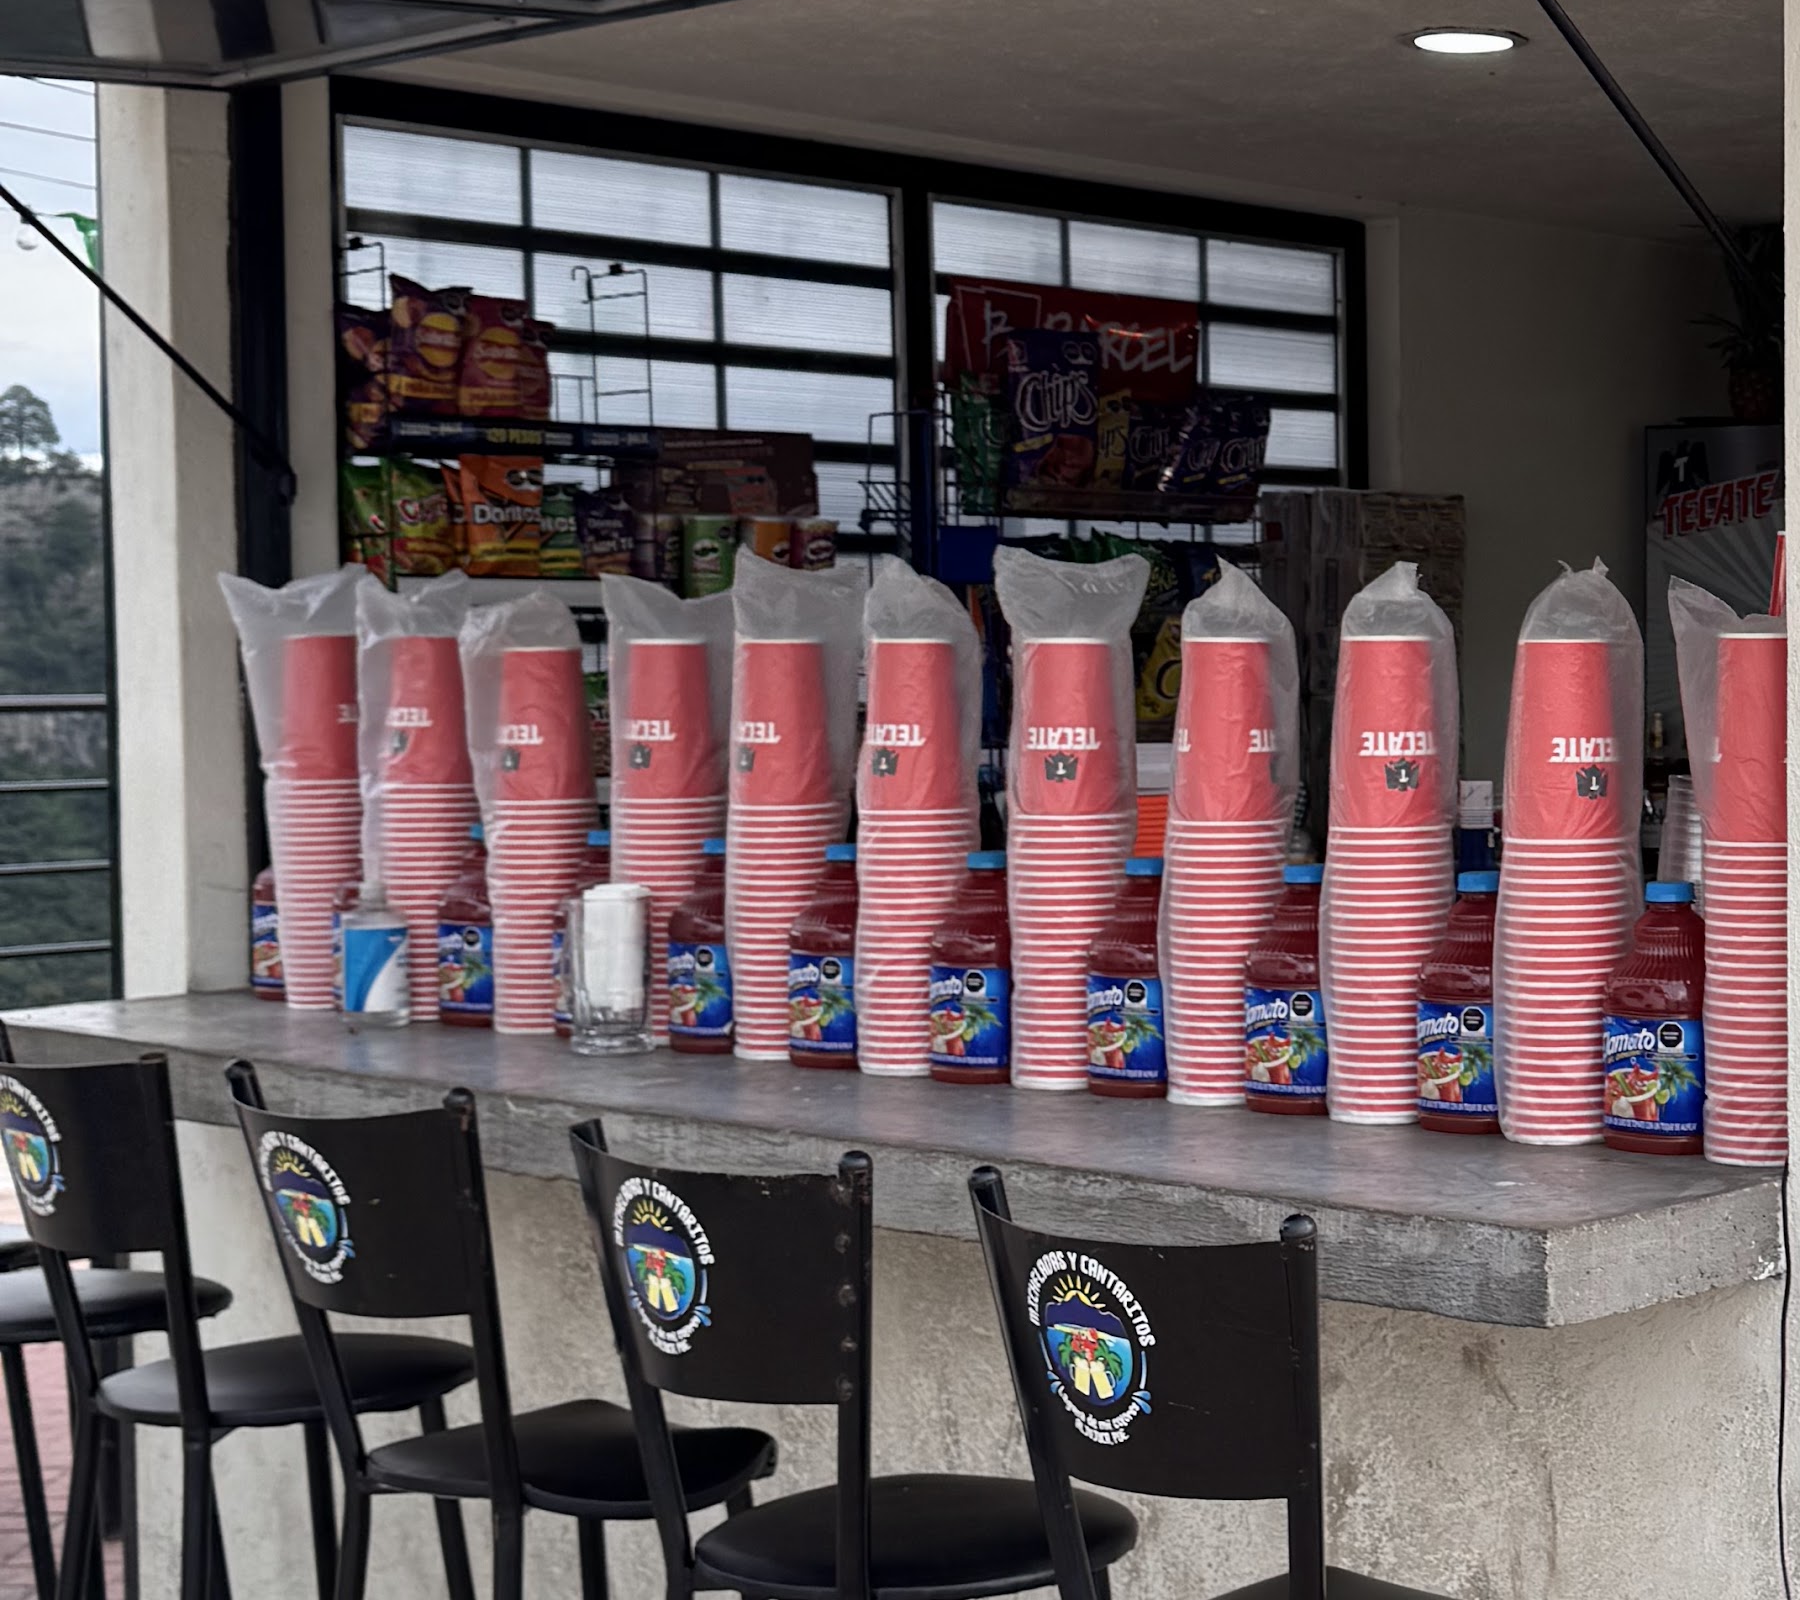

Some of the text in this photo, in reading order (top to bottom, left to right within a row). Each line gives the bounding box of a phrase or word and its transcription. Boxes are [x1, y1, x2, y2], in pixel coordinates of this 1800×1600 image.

[473, 503, 541, 525] Doritos
[1654, 469, 1780, 539] TECATE
[1026, 727, 1101, 750] TECATE
[1548, 737, 1620, 762] ECATE
[652, 1181, 715, 1265] CANTARITOS
[1027, 1250, 1157, 1348] MICHELADAS Y CANTARITOS
